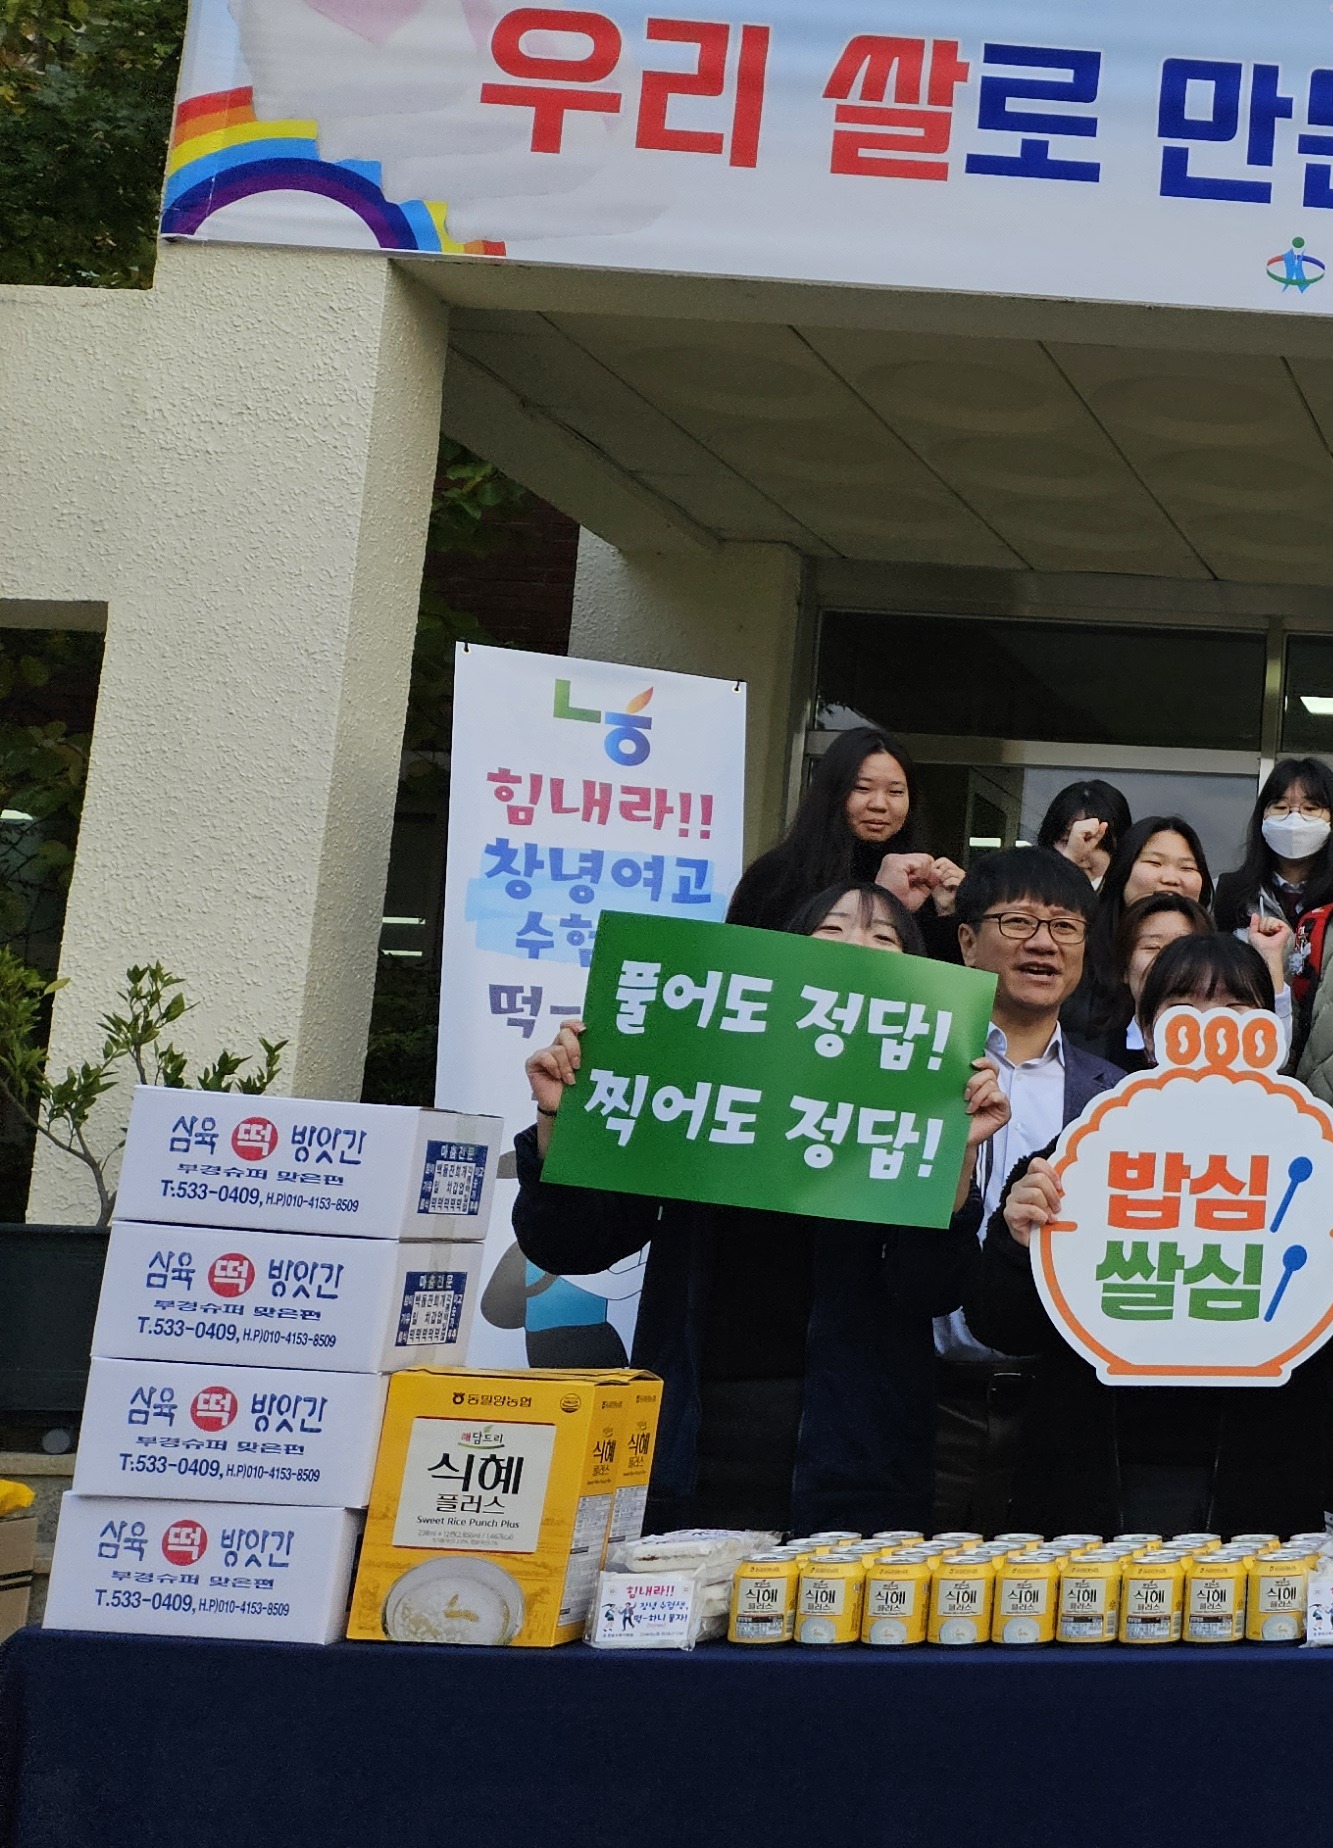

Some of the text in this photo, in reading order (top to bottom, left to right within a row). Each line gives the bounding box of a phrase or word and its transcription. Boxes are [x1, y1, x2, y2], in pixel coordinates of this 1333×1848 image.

[480, 7, 769, 168] 우리
[822, 34, 1101, 182] 쌀로
[487, 767, 713, 839] 힘내라!!
[484, 838, 711, 904] 창녕여고
[615, 960, 952, 1070] 풀어도 정답!
[170, 1115, 367, 1165] 삼육 떡 방앗간
[584, 1069, 943, 1180] 찍어도 정답!
[277, 1170, 344, 1188] 맞은편
[1108, 1151, 1269, 1231] 밥심
[146, 1250, 344, 1299] 삼육 떡 방앗간
[1096, 1241, 1264, 1321] 쌀심
[254, 1306, 321, 1321] 맞은편
[128, 1386, 328, 1434] 삼육 떡 방앗간
[237, 1442, 304, 1456] 맞은편
[593, 1440, 616, 1464] 식혜
[628, 1433, 650, 1455] 식혜
[428, 1453, 524, 1494] 식혜
[417, 1516, 519, 1528] Sweet Rice Punch Plus
[436, 1493, 506, 1515] 플러스
[98, 1520, 294, 1568] 삼육 떡 방앗간
[209, 1575, 274, 1590] 맞은편
[627, 1585, 675, 1597] 힘내라!!
